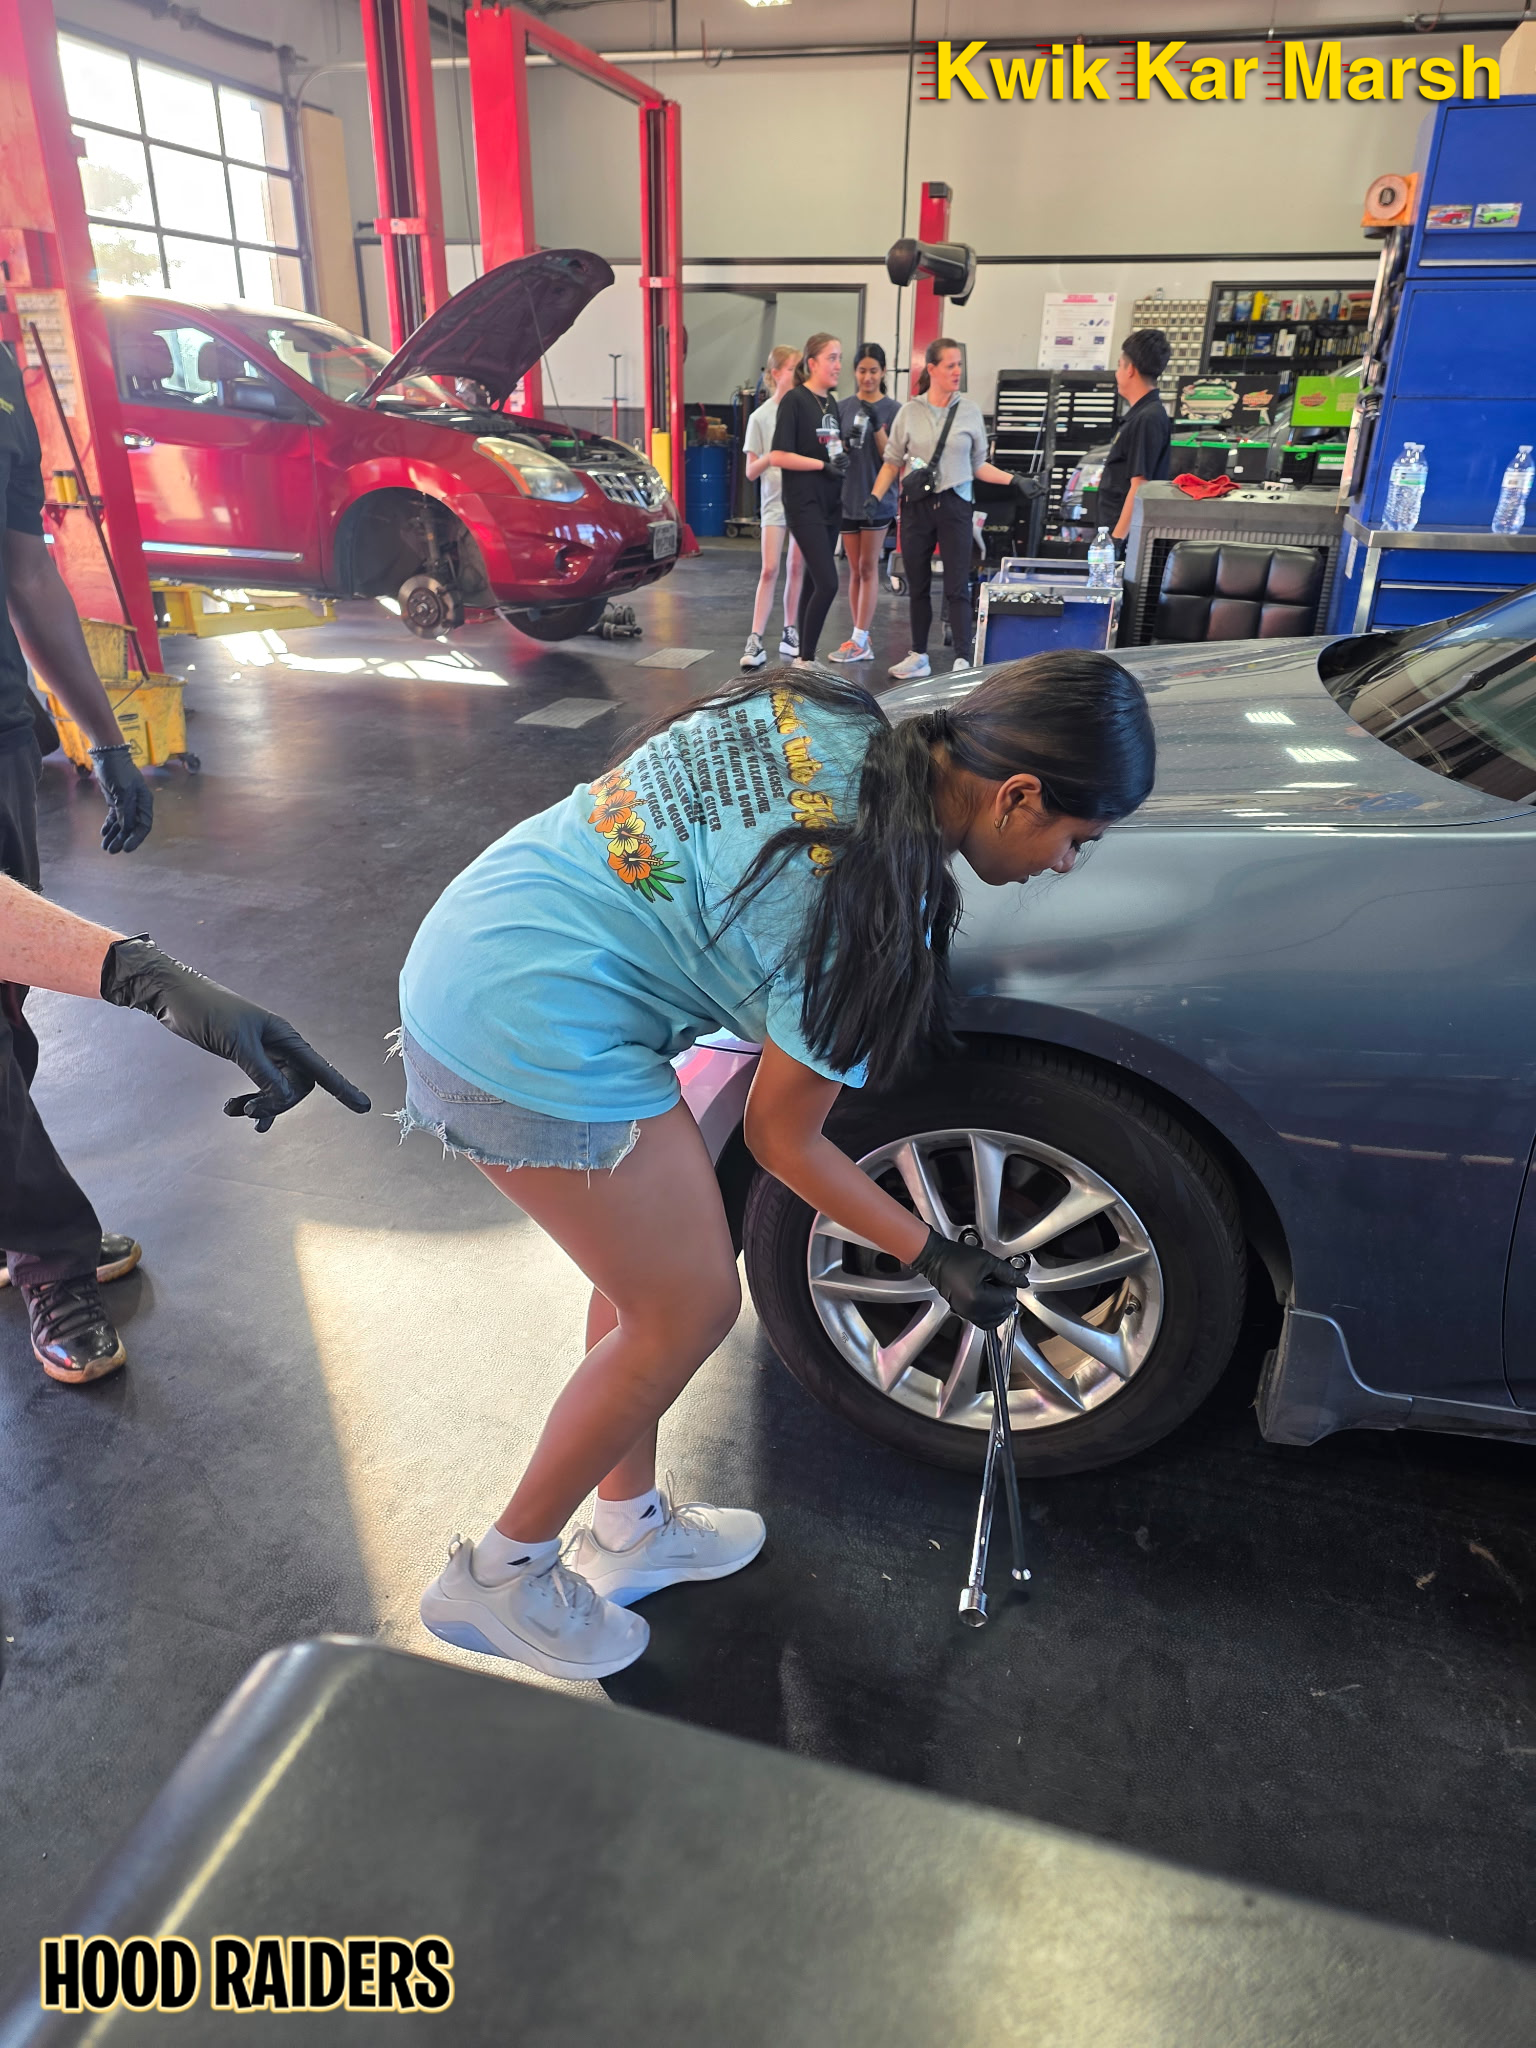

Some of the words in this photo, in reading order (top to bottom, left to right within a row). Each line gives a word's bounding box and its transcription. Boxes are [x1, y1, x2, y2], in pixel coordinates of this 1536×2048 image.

[696, 758, 714, 793] DENTON
[711, 754, 725, 766] AT
[735, 708, 748, 725] SEP
[746, 755, 771, 814] WAXAHACHIE
[753, 718, 768, 737] AUG
[766, 764, 785, 799] SACHSE
[654, 770, 674, 803] FLOWER
[666, 803, 690, 842] MOUND
[715, 768, 734, 807] HEBRON
[727, 745, 748, 792] ARLINGTON
[738, 793, 757, 829] BOWIE
[645, 792, 667, 830] MARCUS
[703, 795, 722, 832] GUYER
